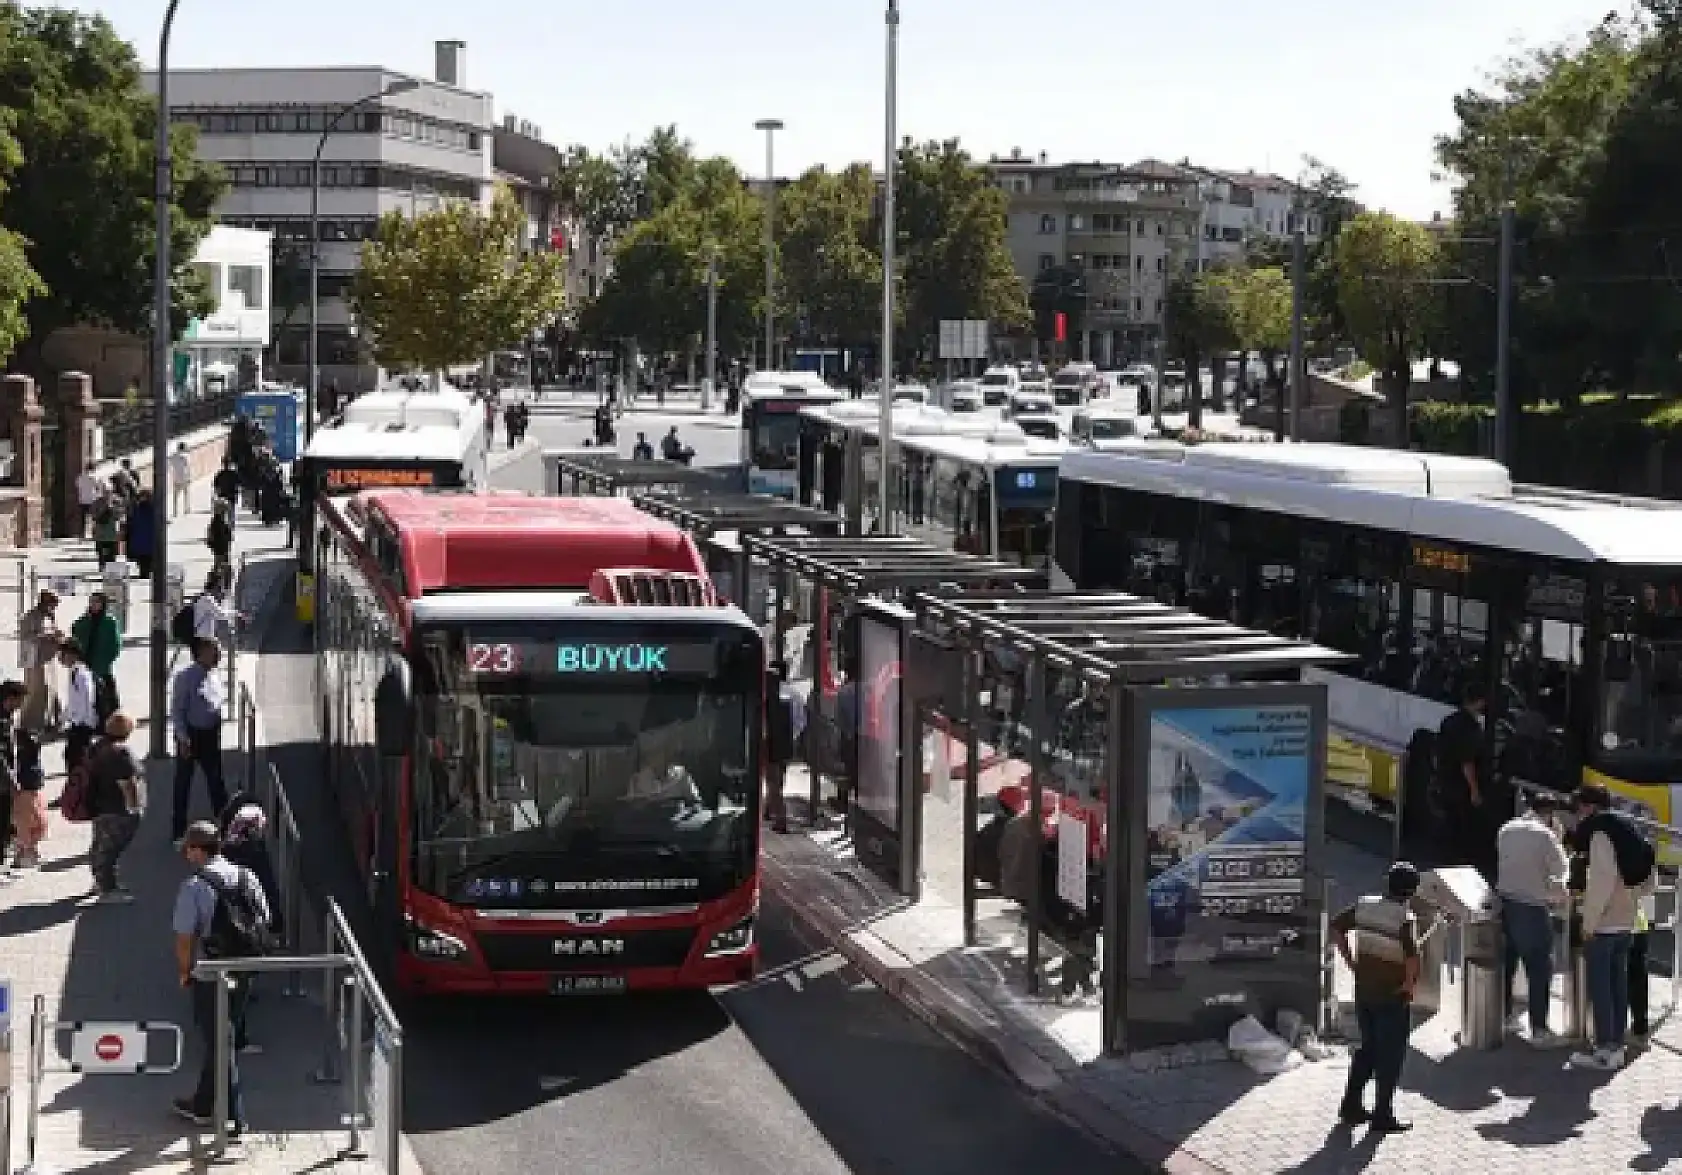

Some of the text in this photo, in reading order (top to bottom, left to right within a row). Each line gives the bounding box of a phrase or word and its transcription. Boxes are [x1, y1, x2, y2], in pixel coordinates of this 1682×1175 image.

[470, 643, 669, 672] 23 BÜYÜK
[554, 939, 625, 955] MAN
